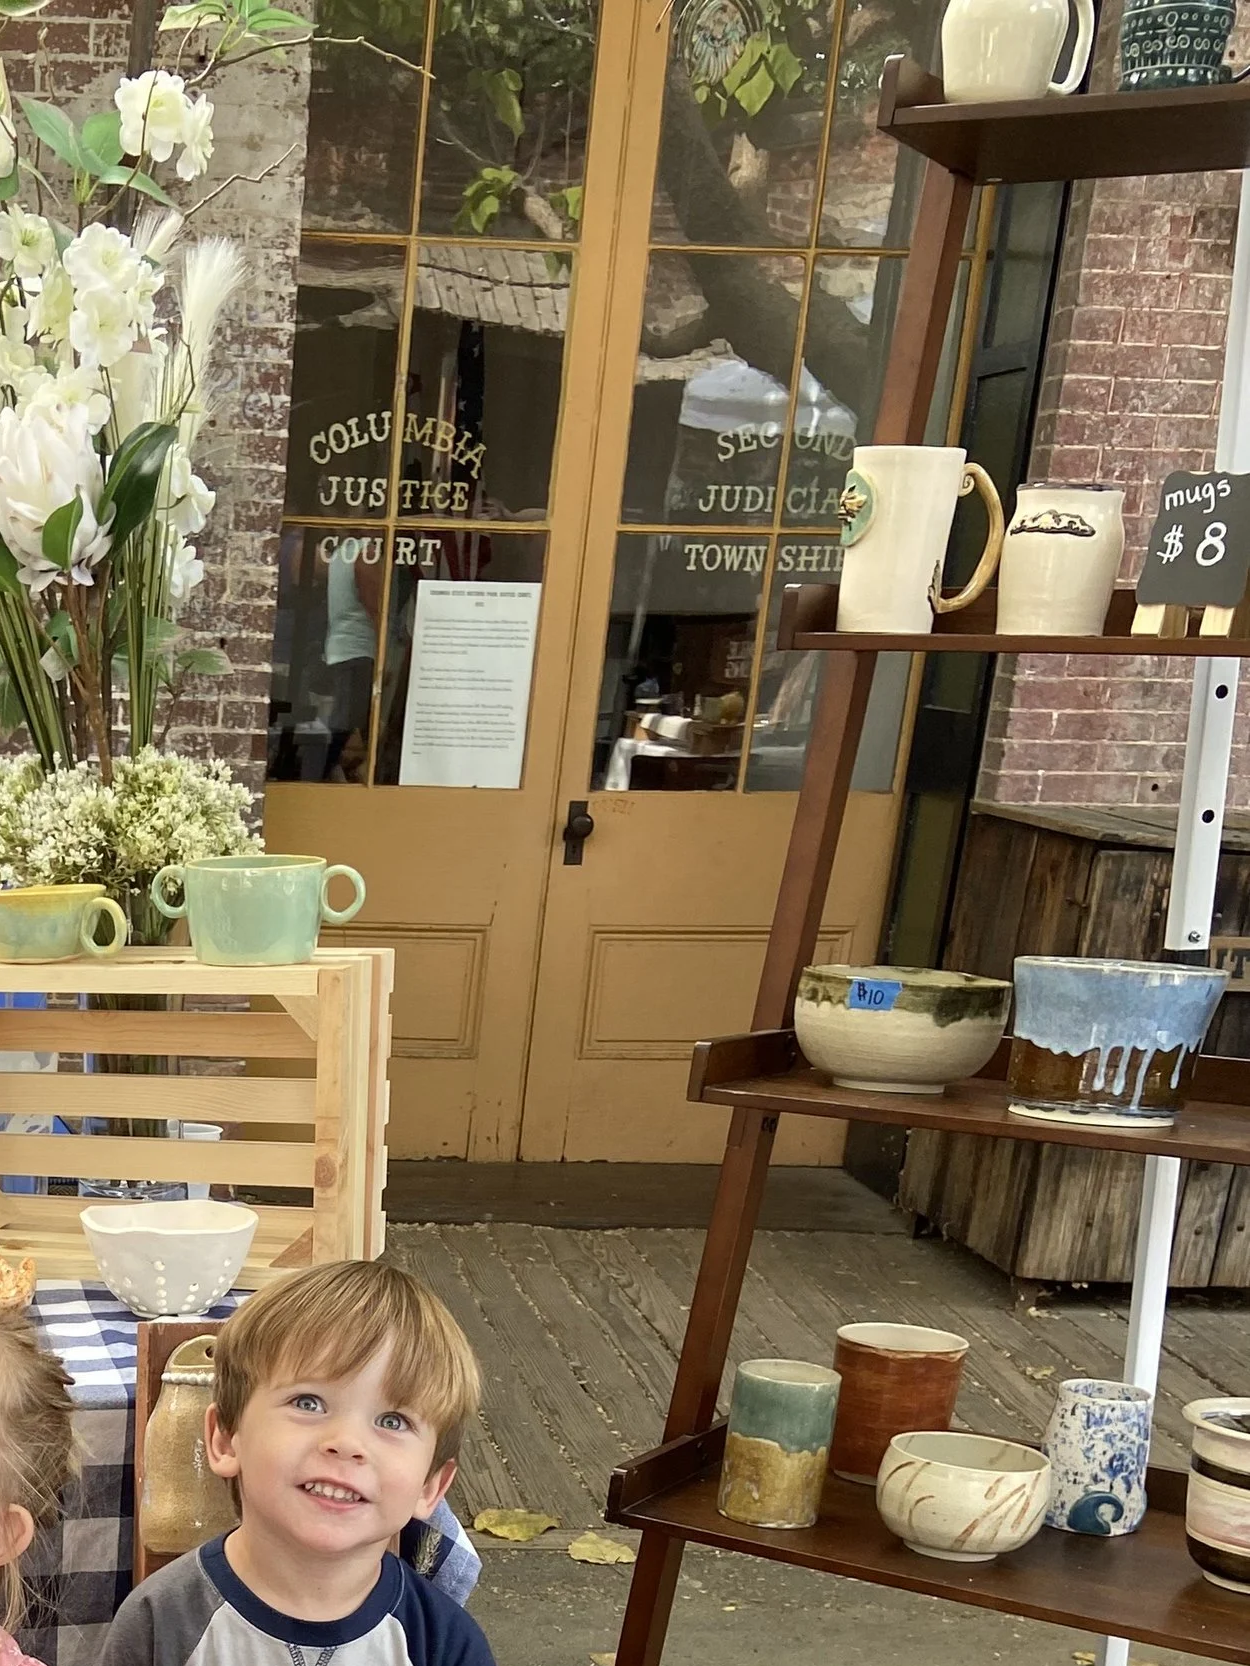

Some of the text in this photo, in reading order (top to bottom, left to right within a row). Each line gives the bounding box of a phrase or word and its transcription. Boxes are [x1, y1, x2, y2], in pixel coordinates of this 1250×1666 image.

[309, 411, 487, 479] COLUMBIA
[319, 476, 469, 511] JUSTICE
[698, 484, 842, 514] JUDICIA
[1165, 479, 1231, 514] mugs
[319, 535, 442, 566] COURT
